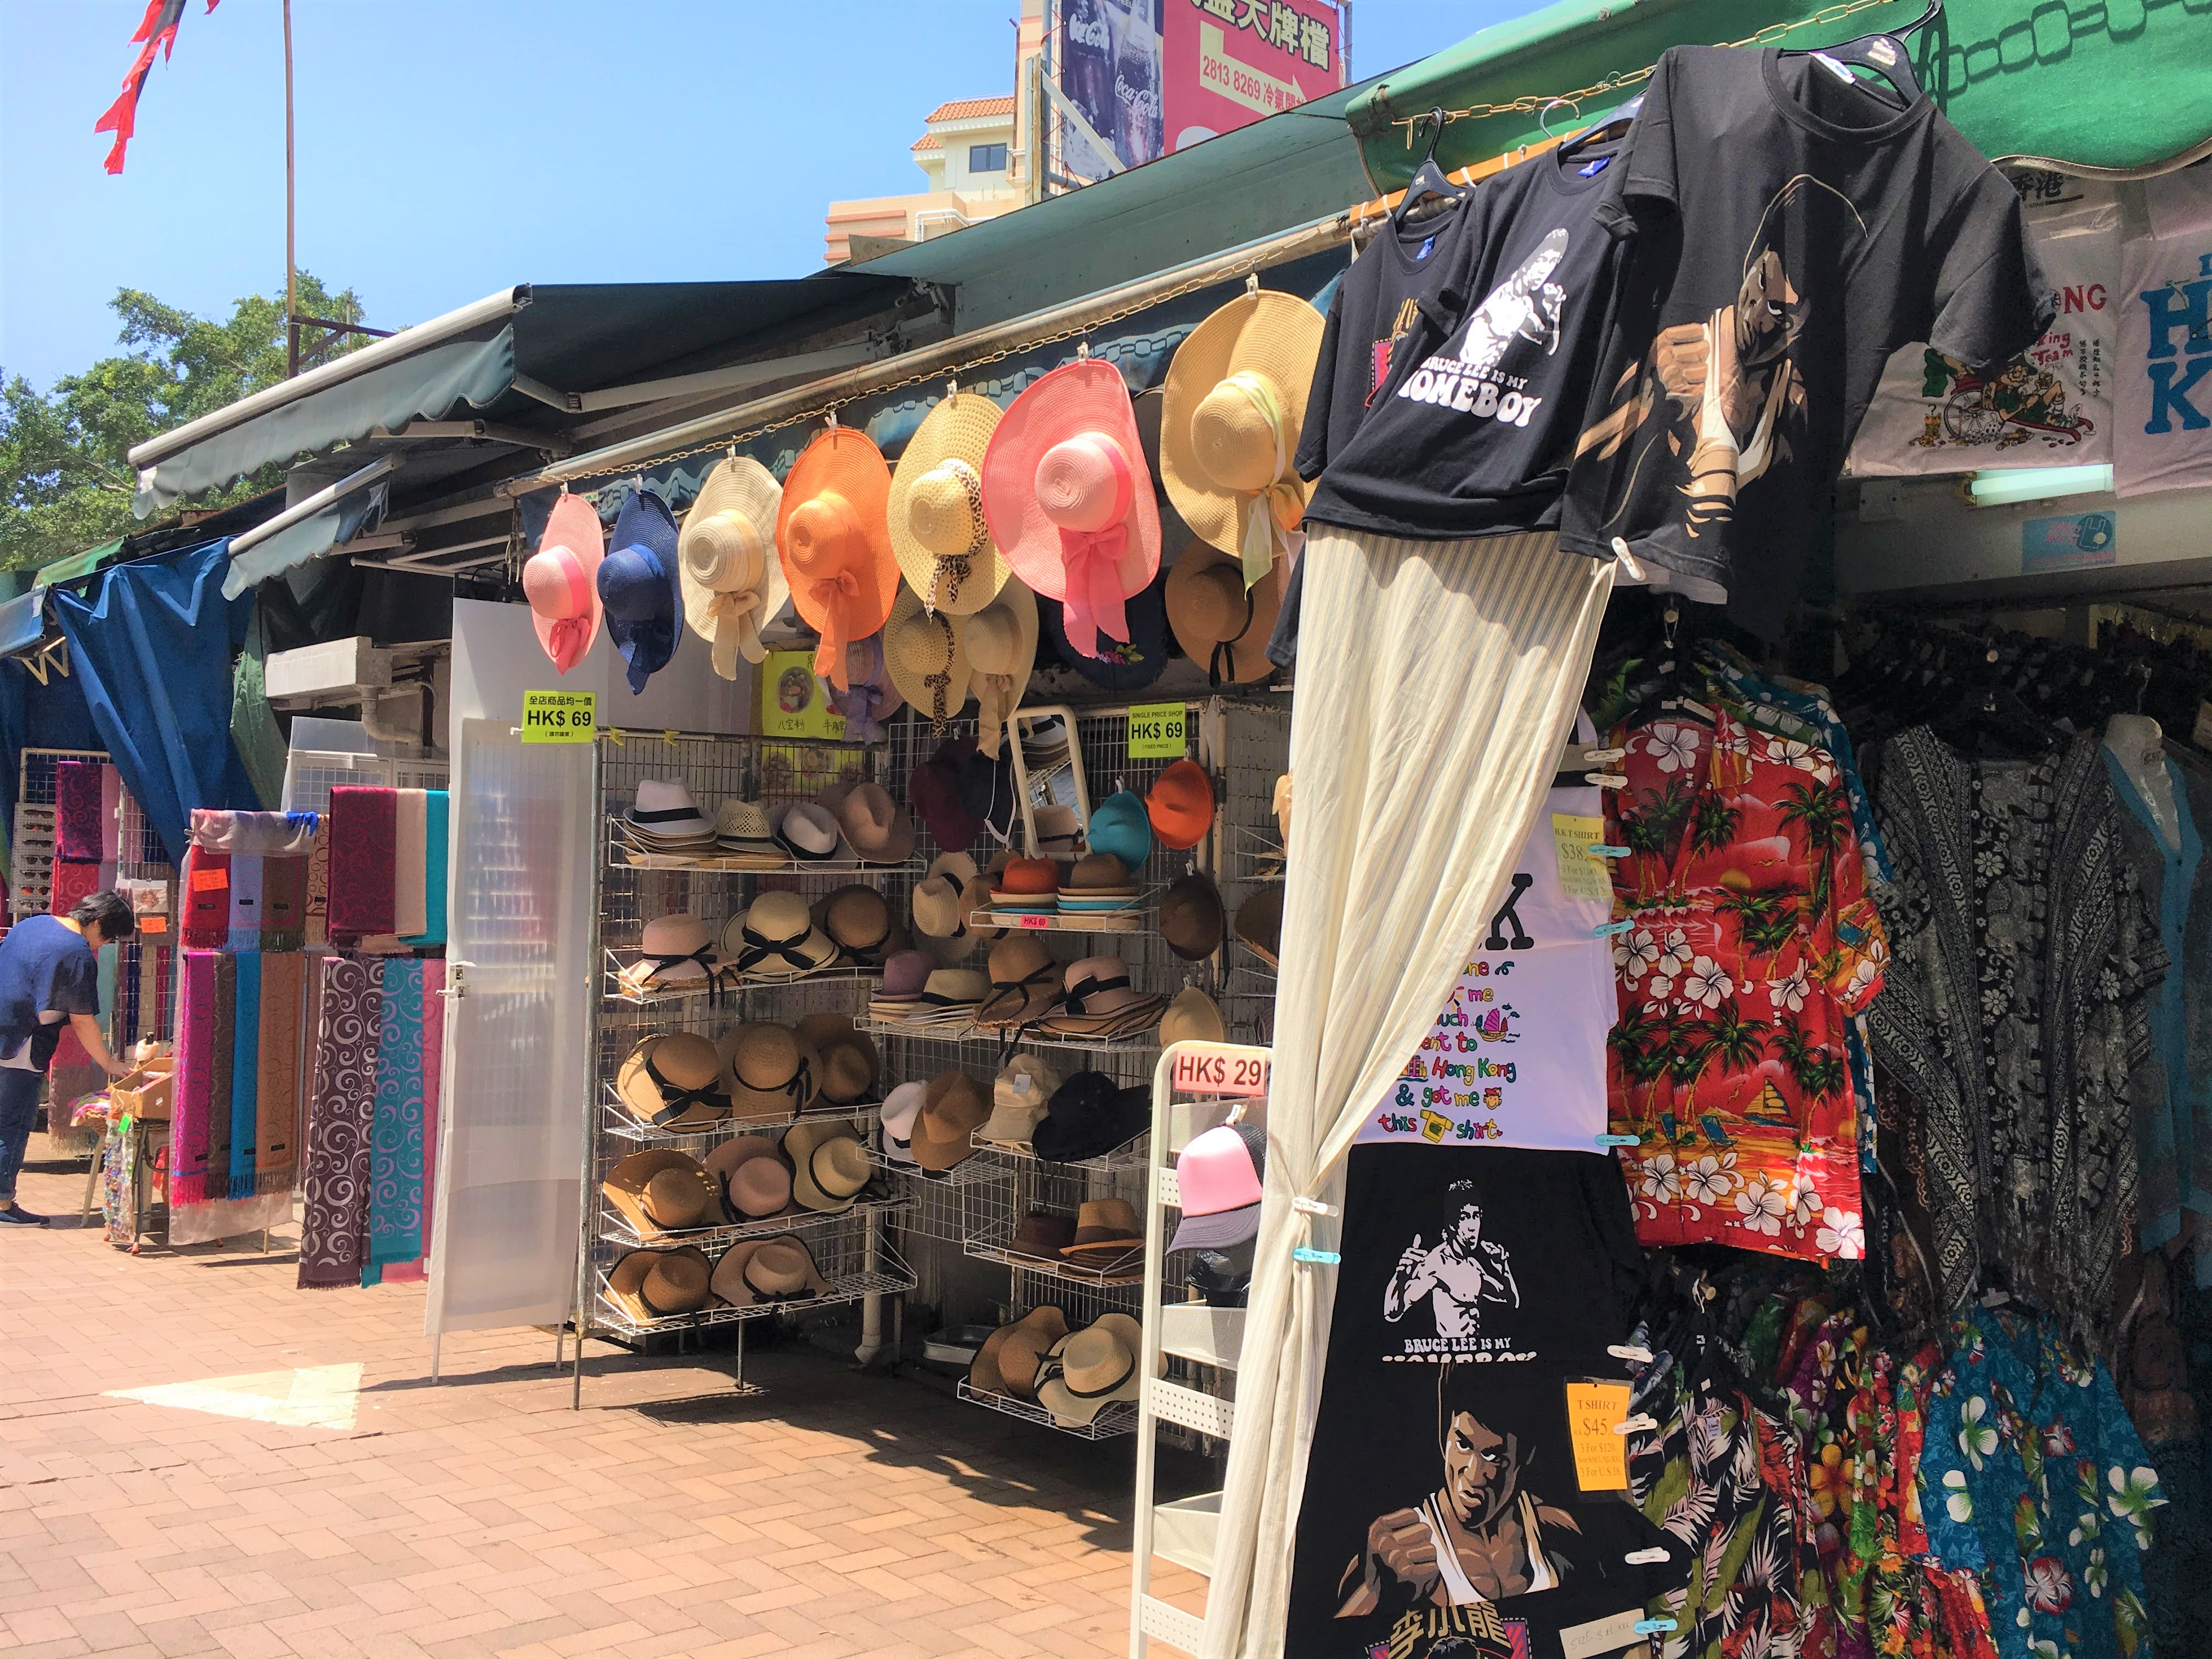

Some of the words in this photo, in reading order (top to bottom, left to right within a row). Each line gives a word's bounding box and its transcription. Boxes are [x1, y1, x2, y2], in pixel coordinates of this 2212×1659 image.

[1203, 55, 1229, 86] 2813
[1234, 70, 1261, 100] 8269
[2030, 349, 2073, 366] Team
[1464, 363, 1491, 380] LEE
[1491, 369, 1505, 383] IS
[1506, 375, 1528, 390] MY
[529, 696, 592, 706] 全店商品均一價
[528, 709, 566, 727] HK$
[572, 711, 591, 726] 69
[1131, 721, 1161, 741] HK$
[1166, 721, 1182, 738] 69
[1574, 831, 1600, 840] SHIRT
[1024, 917, 1037, 926] HK$
[1463, 961, 1489, 977] ne
[1468, 988, 1494, 1002] me
[1419, 1031, 1452, 1052] ent
[1455, 1031, 1477, 1053] to
[1180, 1056, 1226, 1087] HK$
[1233, 1059, 1261, 1086] 29
[1431, 1056, 1475, 1086] Hong
[1478, 1058, 1516, 1084] Kong
[1395, 1084, 1415, 1107] &
[1421, 1085, 1452, 1108] got
[1454, 1091, 1480, 1107] me
[1378, 1113, 1418, 1132] this
[1456, 1118, 1497, 1141] shirt
[1404, 1339, 1448, 1353] BRUCE
[1451, 1337, 1477, 1351] LEE
[1480, 1338, 1493, 1350] IS
[1494, 1337, 1511, 1349] MY
[1578, 1400, 1583, 1409] T
[1585, 1400, 1618, 1410] SHIRT
[1581, 1443, 1584, 1453] 3
[1586, 1443, 1598, 1453] For
[1581, 1468, 1584, 1477] 3
[1586, 1467, 1598, 1477] For
[1388, 1601, 1513, 1659] 李小龍
